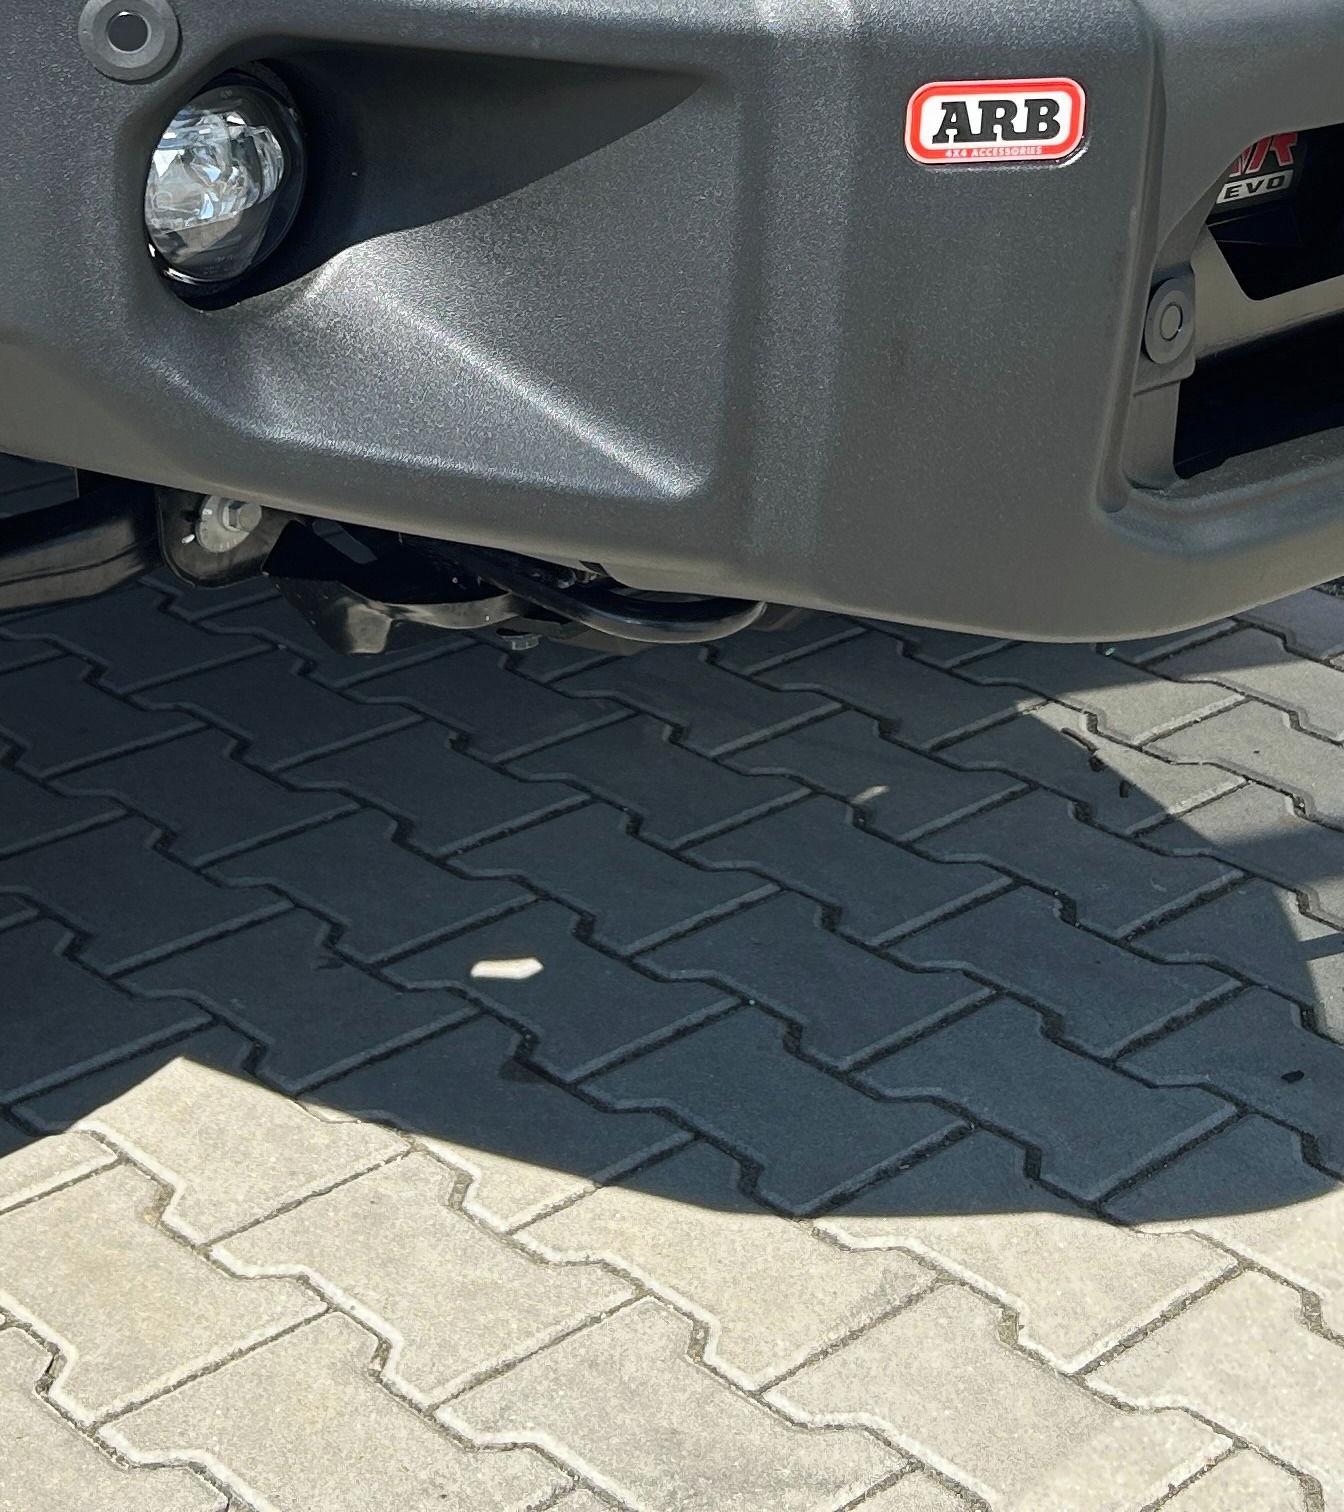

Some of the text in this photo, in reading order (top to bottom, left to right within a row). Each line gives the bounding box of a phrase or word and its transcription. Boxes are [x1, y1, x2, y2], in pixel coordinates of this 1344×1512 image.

[931, 98, 1061, 145] ARB
[971, 145, 1043, 158] ACCESSORIES
[1223, 174, 1286, 200] EVO
